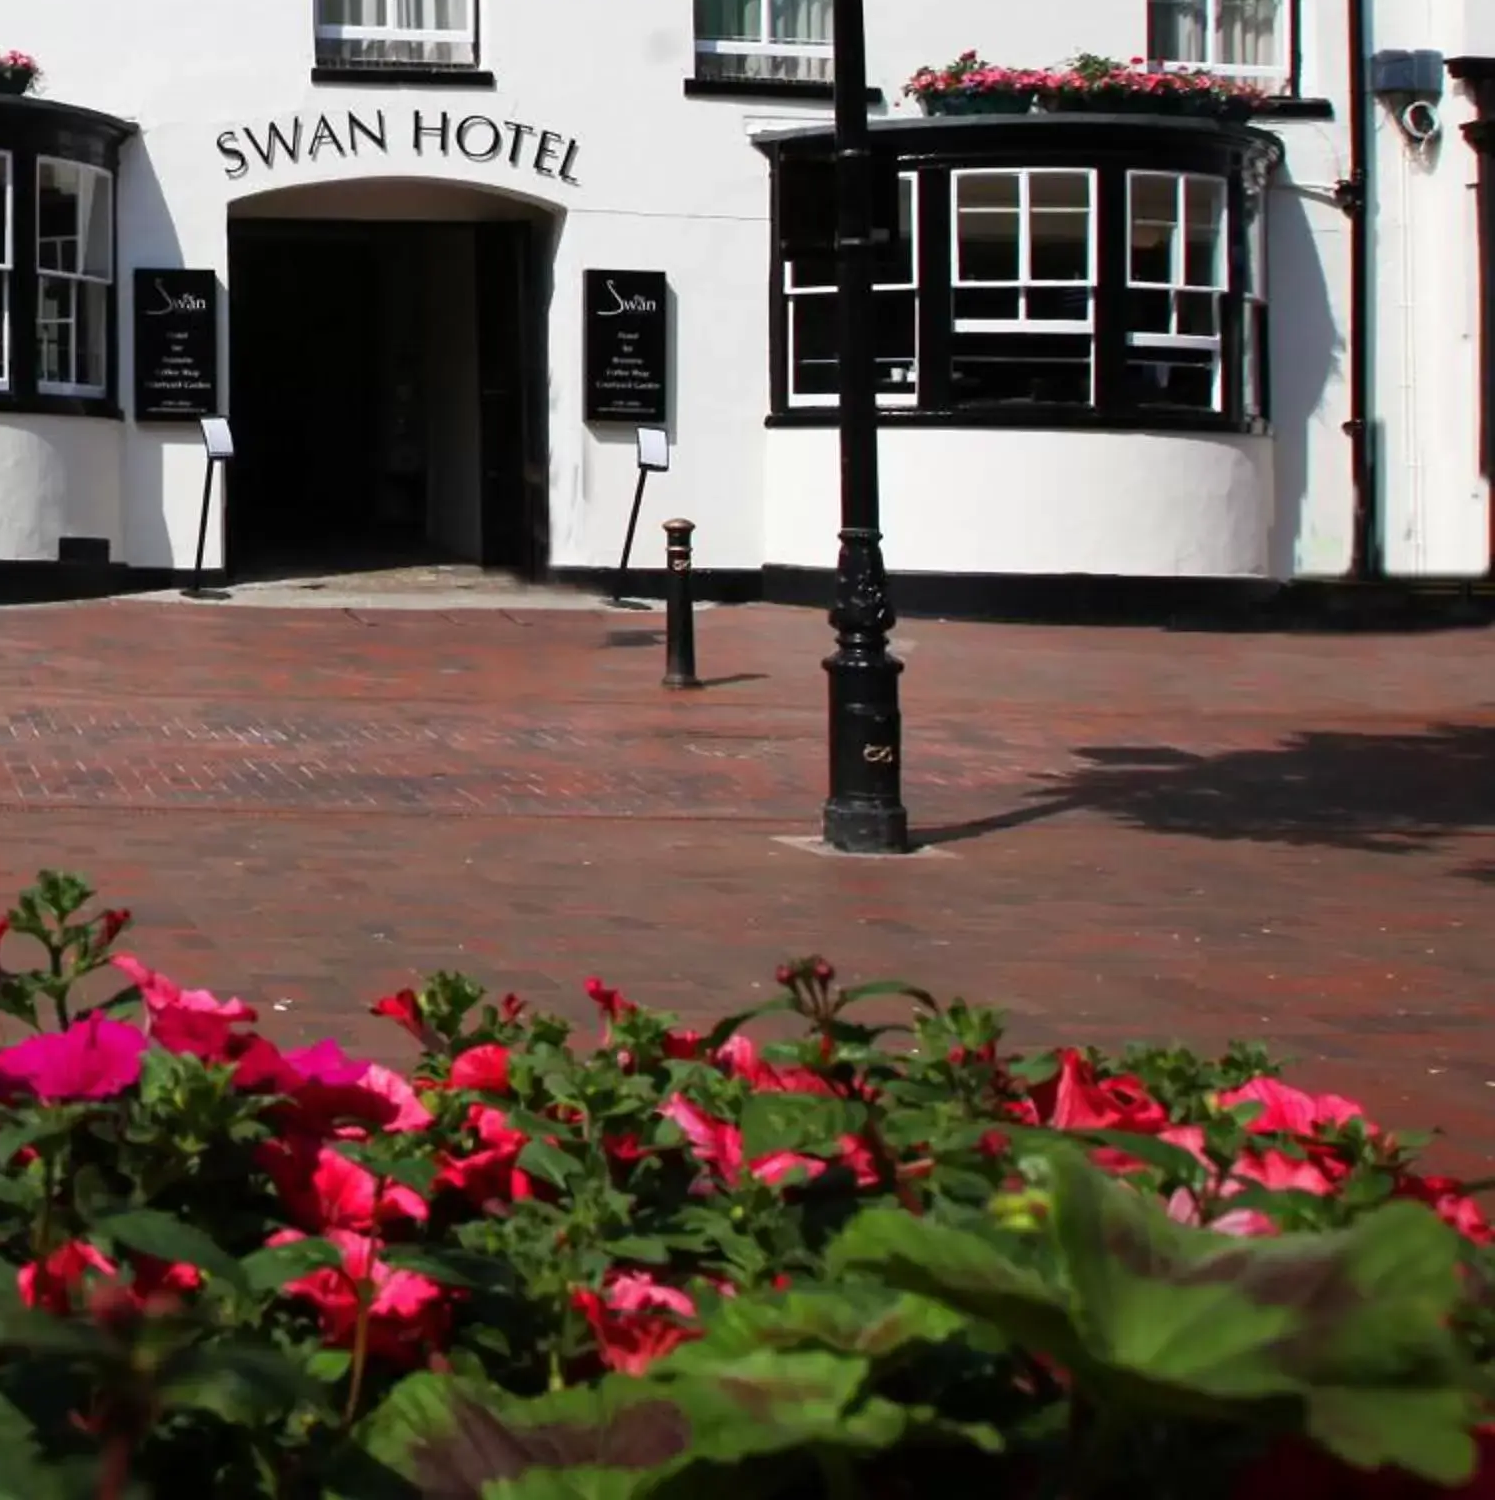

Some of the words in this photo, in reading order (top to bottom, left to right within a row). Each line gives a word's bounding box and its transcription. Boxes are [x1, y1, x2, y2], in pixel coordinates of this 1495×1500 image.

[216, 109, 387, 178] SWAN
[413, 109, 580, 185] HOTEL
[596, 279, 657, 315] Swan
